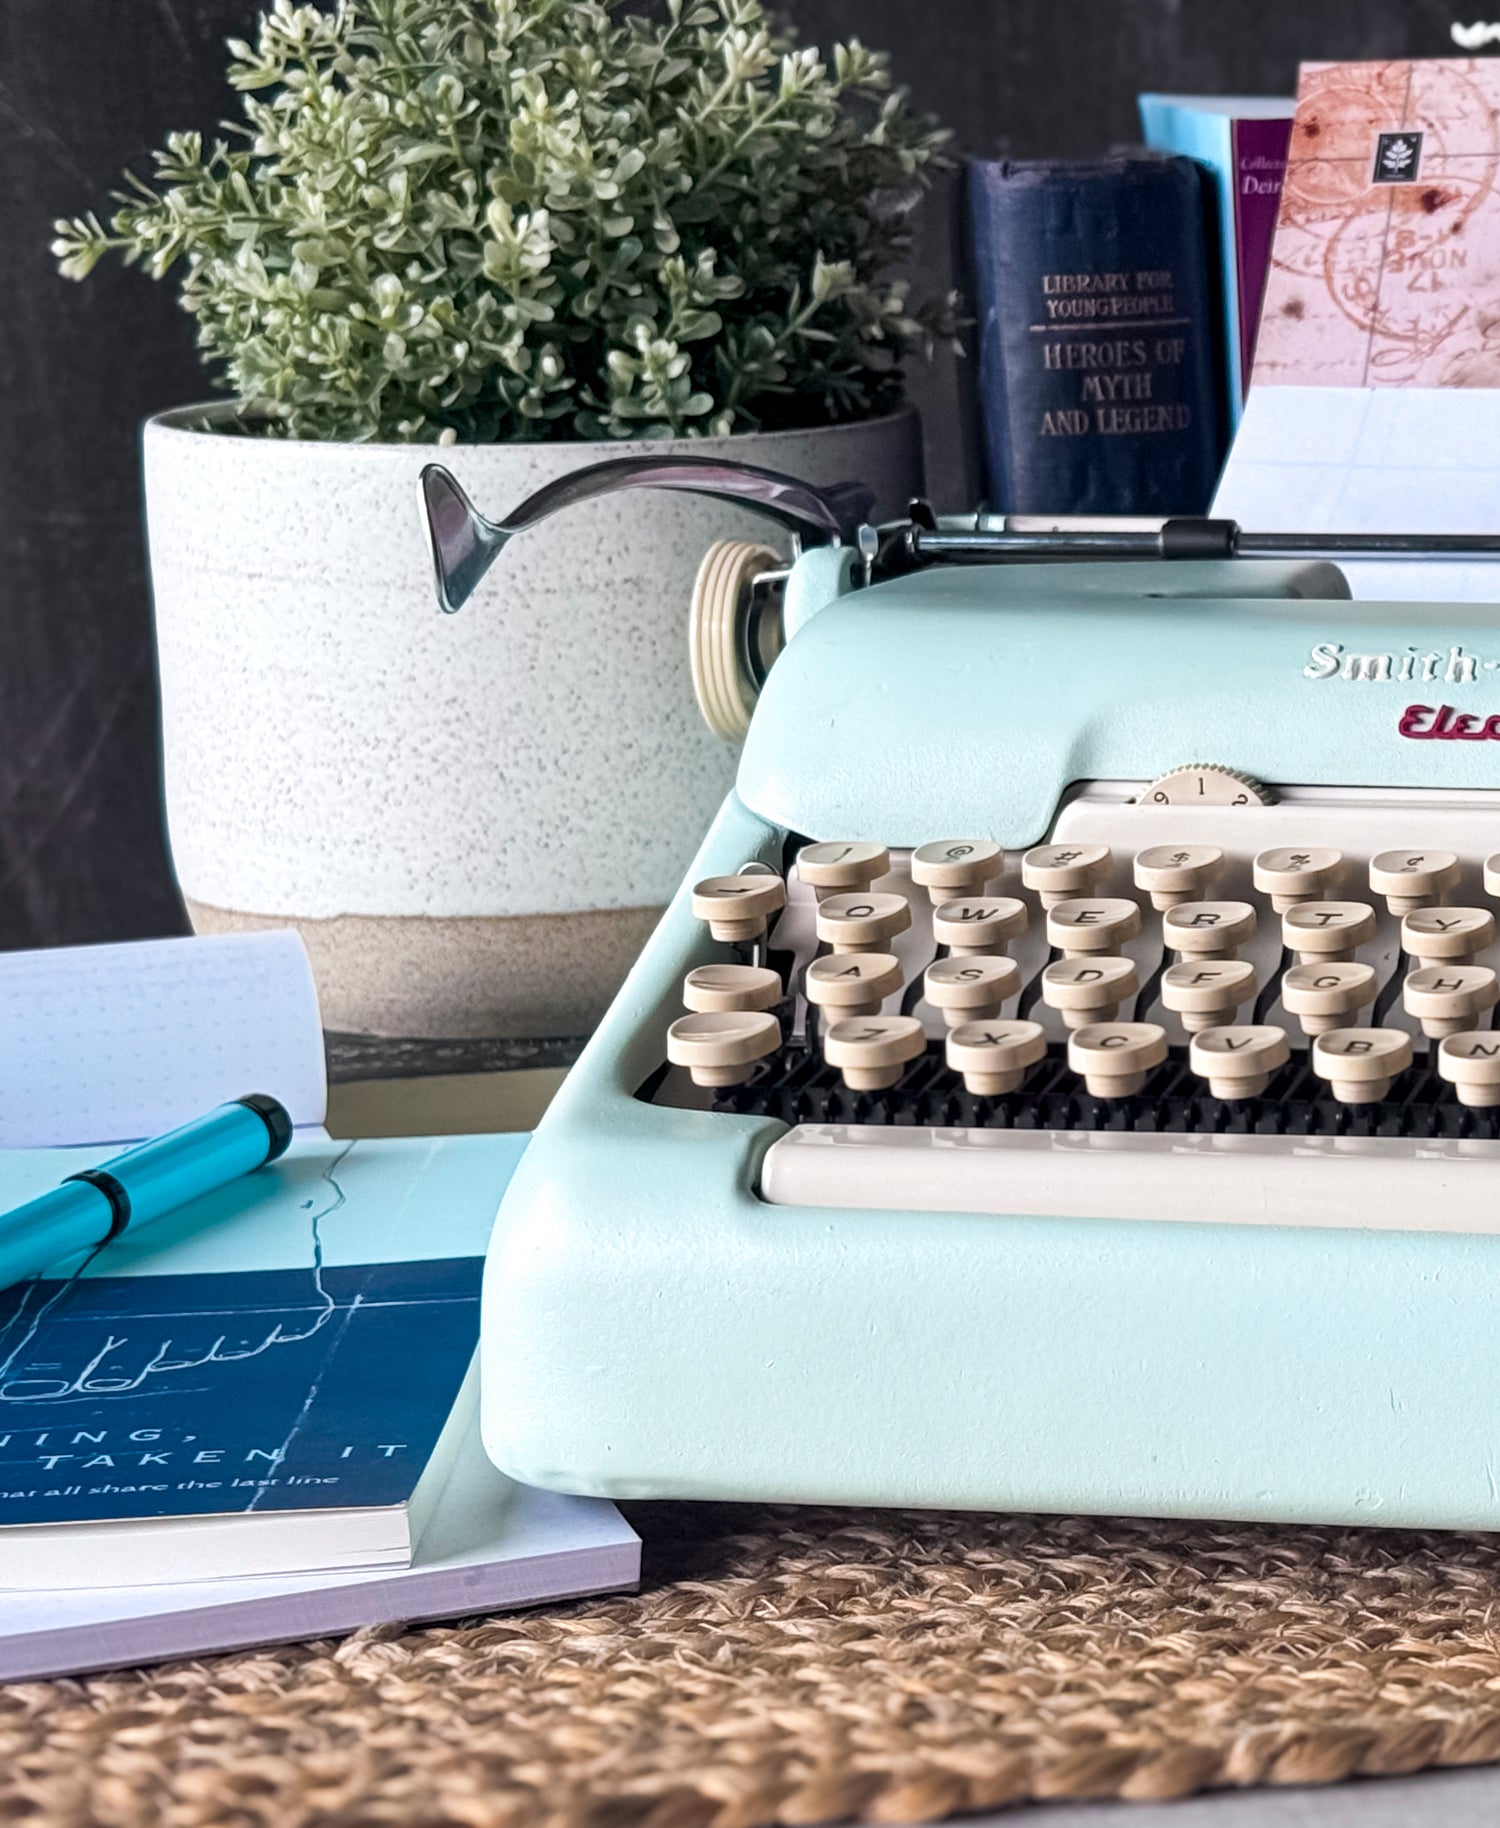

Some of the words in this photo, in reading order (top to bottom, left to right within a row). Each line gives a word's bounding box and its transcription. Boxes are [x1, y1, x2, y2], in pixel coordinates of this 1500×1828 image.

[1042, 273, 1129, 294] LIBRARY
[1137, 271, 1173, 290] FOR
[1046, 297, 1110, 319] YOUNG
[1111, 295, 1175, 316] PEOPLE
[1043, 340, 1147, 369] HEROES
[1156, 338, 1185, 364] OF
[1083, 372, 1152, 401] MYTH
[1040, 408, 1089, 436] AND
[1097, 404, 1191, 434] LEGEND
[945, 845, 975, 858] @
[960, 908, 998, 921] W
[1073, 911, 1106, 924] E
[1190, 913, 1222, 926] R
[1314, 913, 1344, 926] T
[1435, 918, 1462, 931] Y
[834, 965, 862, 978] A
[953, 968, 984, 982] S
[1072, 969, 1104, 982] D
[1190, 972, 1222, 985] F
[1312, 975, 1341, 989] G
[1431, 978, 1464, 991] H
[855, 1028, 888, 1041] Z
[973, 1031, 1010, 1046] X
[1099, 1035, 1129, 1048] C
[1225, 1036, 1254, 1050] V
[1343, 1040, 1374, 1053] B
[1469, 1043, 1500, 1056] N
[37, 1449, 286, 1471] TAKEN
[340, 1444, 408, 1459] IT
[43, 1485, 82, 1497] all
[88, 1484, 169, 1495] share
[176, 1480, 223, 1490] the
[230, 1477, 280, 1488] last
[285, 1475, 341, 1487] line
